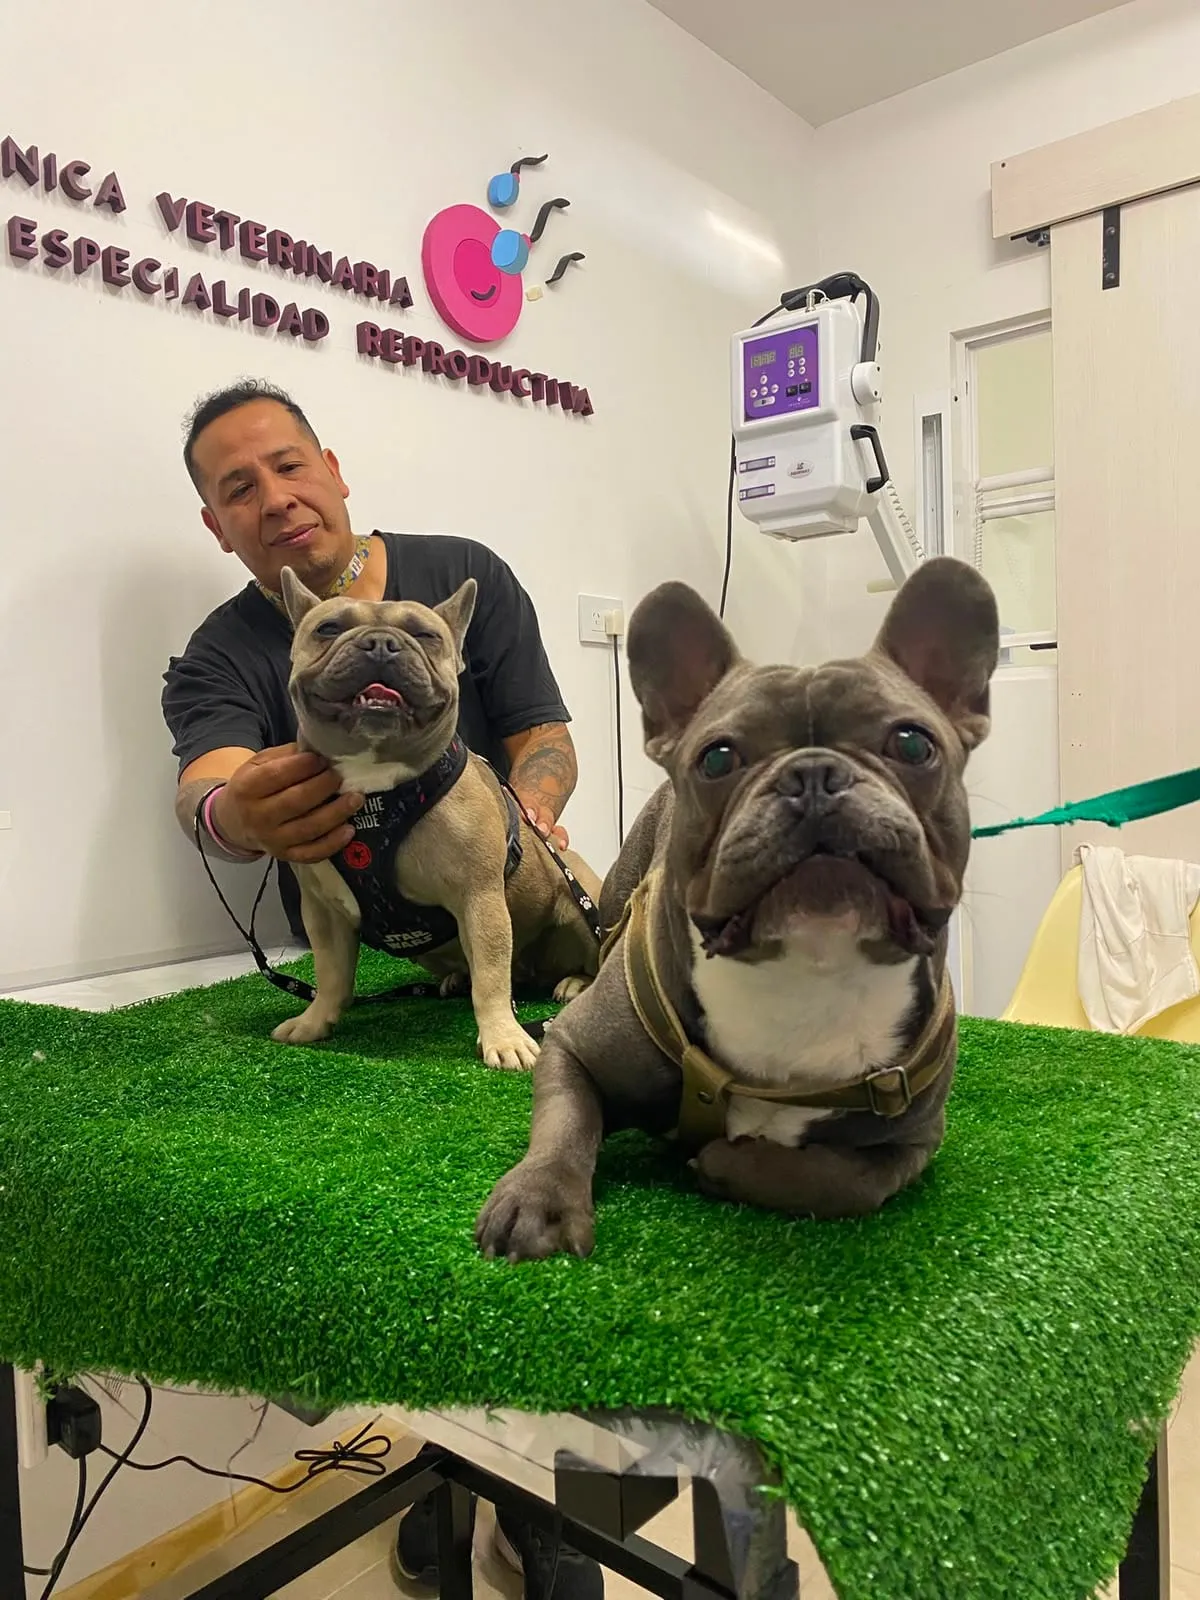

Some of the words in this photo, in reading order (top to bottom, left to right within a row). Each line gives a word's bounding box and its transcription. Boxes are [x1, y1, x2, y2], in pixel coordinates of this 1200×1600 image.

[155, 191, 413, 308] VETERINARIA
[8, 215, 329, 340] ESPECIALIDAD
[357, 321, 594, 416] REPRODUCTIVA
[353, 813, 380, 830] SIDE
